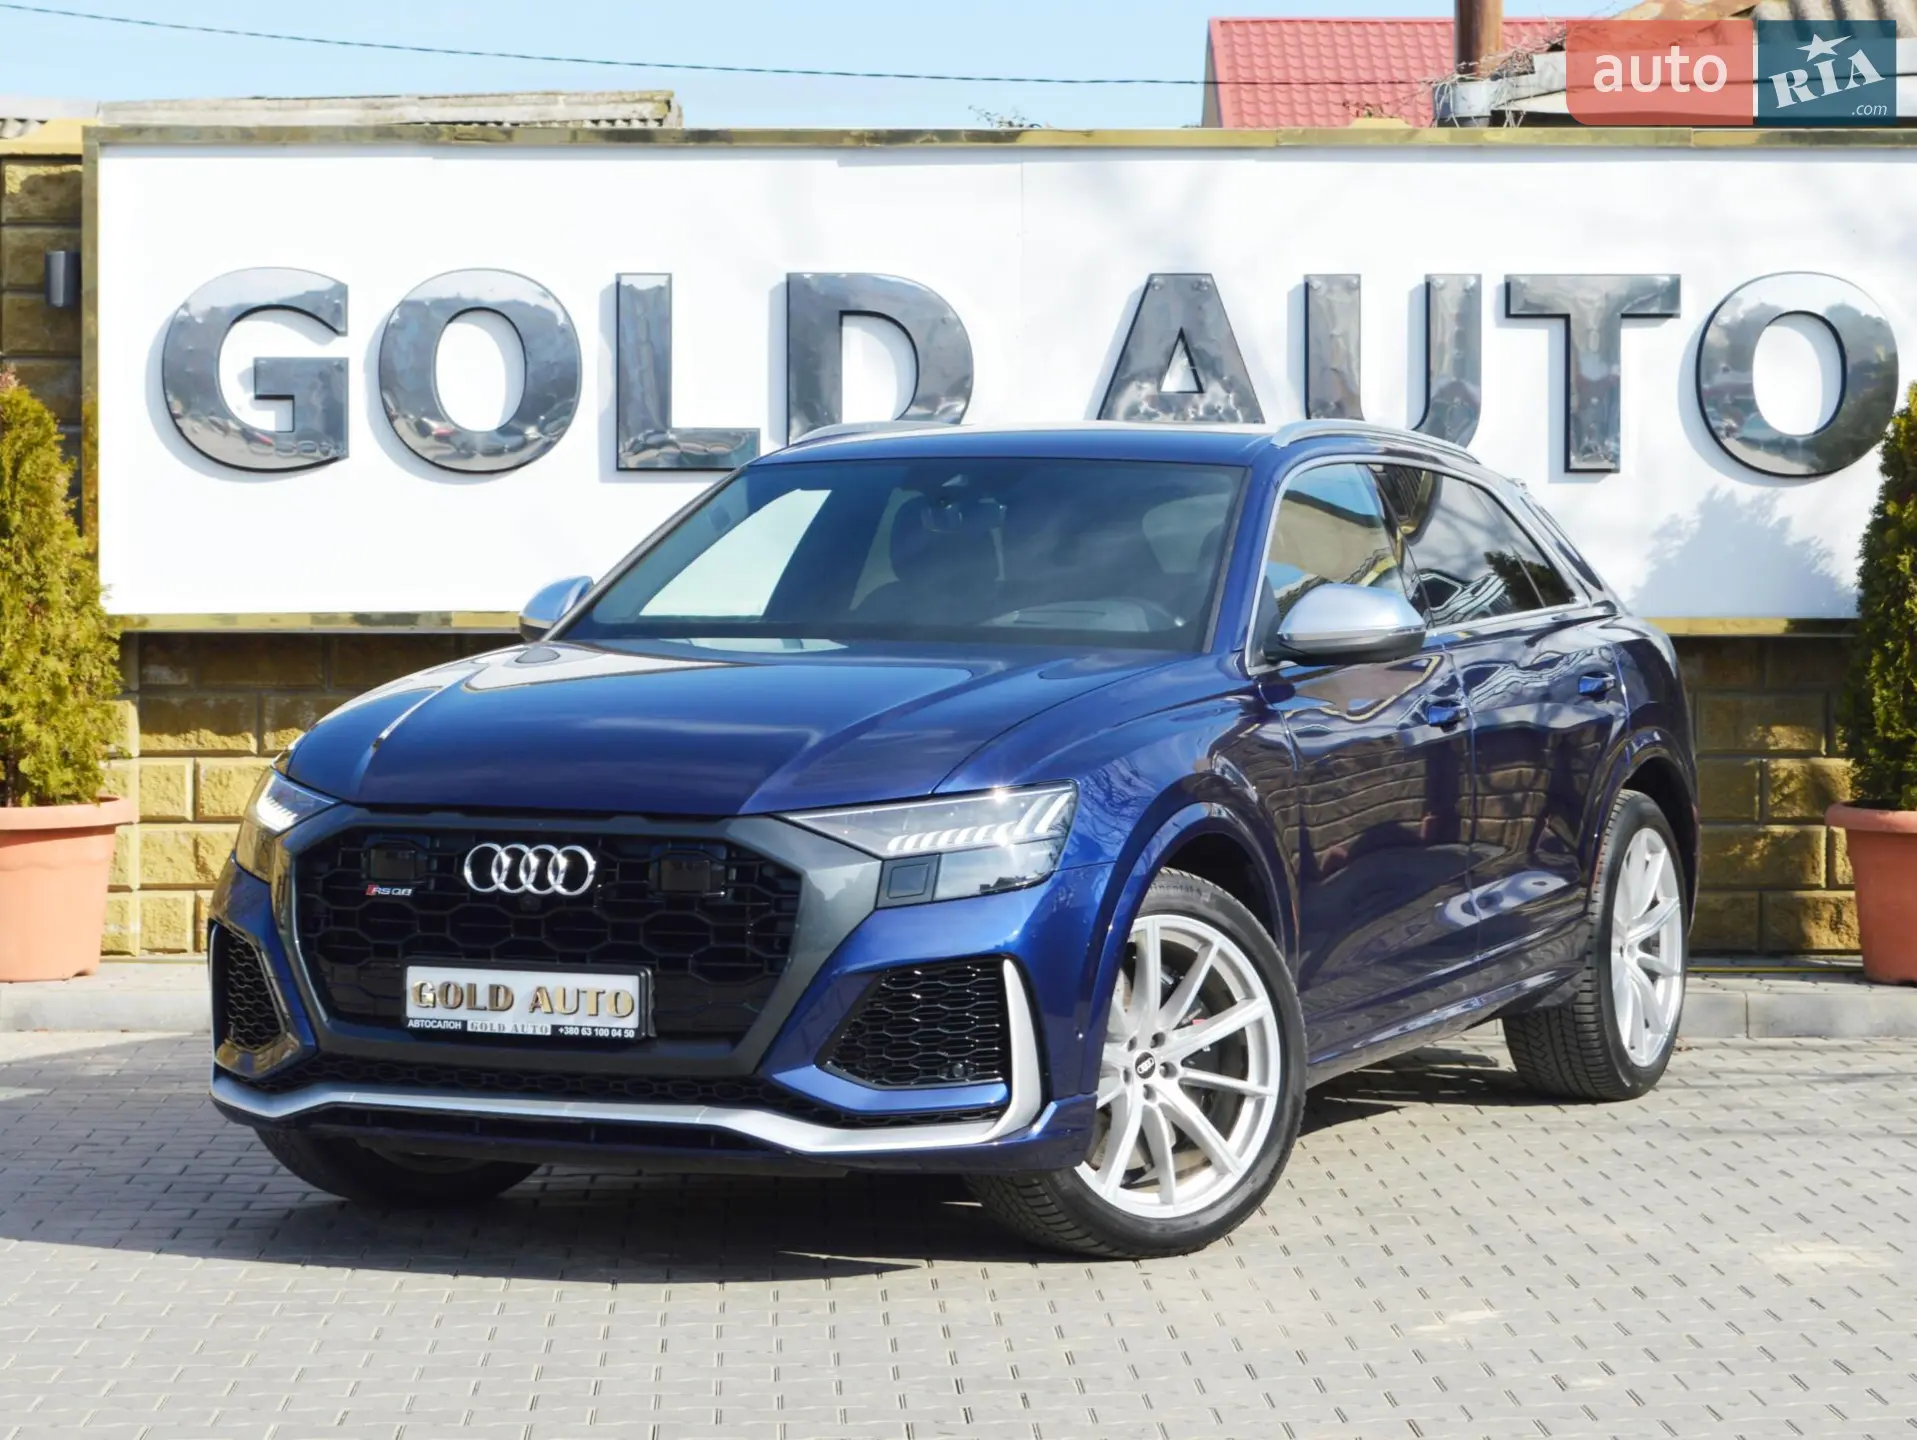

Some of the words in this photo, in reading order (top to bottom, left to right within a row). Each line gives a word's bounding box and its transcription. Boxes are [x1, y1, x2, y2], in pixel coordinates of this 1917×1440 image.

[161, 266, 975, 475] GOLD
[1096, 270, 1900, 478] AUTO
[412, 980, 514, 1012] GOLD
[529, 985, 635, 1018] AUTO
[407, 1018, 462, 1030] АВТОСАЛОН
[470, 1020, 506, 1032] GOLD
[511, 1023, 550, 1035] AUTO
[558, 1026, 580, 1036] +380
[581, 1027, 593, 1036] 63
[594, 1028, 610, 1037] 100
[611, 1028, 622, 1038] 04
[624, 1029, 635, 1038] 50
